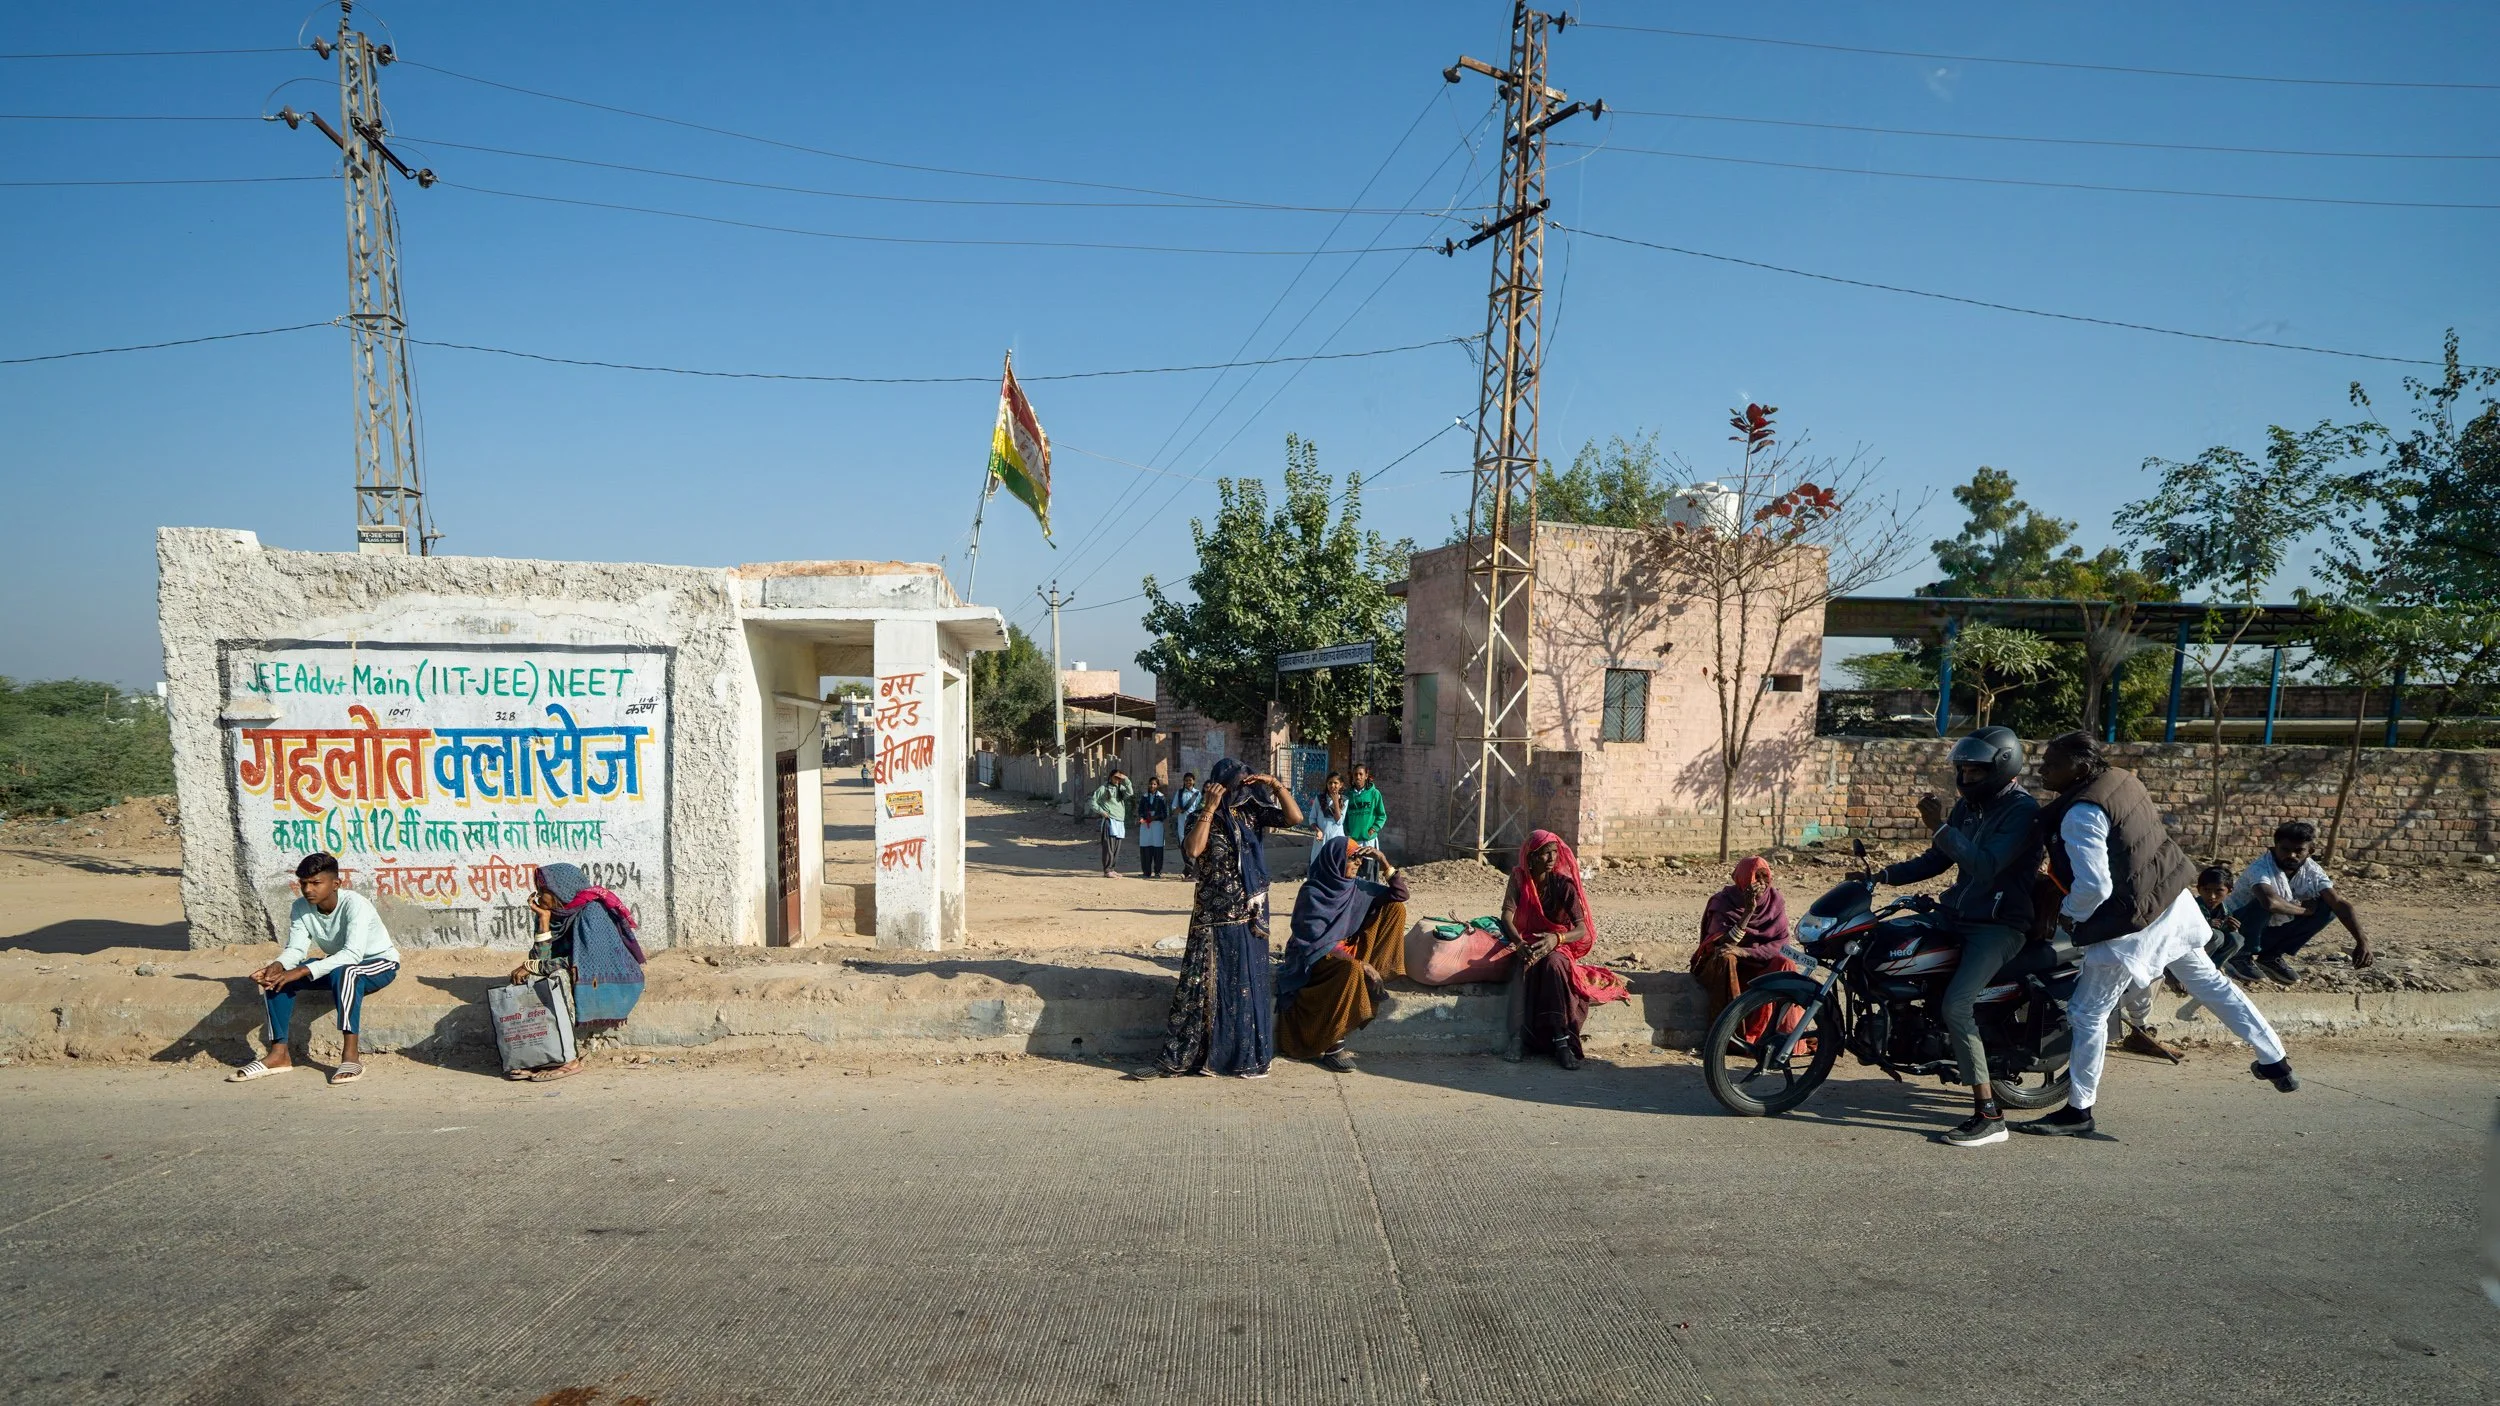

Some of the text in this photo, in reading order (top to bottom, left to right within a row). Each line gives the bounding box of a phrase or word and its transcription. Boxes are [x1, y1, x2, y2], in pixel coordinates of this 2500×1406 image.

[353, 664, 409, 697] Main
[415, 658, 539, 706] (IIT-JEE)
[548, 668, 634, 698] NEET
[878, 672, 926, 697] बस
[495, 711, 516, 721] 328
[239, 703, 650, 815] गहलोत क्लासेज
[874, 734, 935, 785] बीनावास
[272, 819, 321, 855] कक्षा
[325, 806, 343, 853] 6
[347, 806, 367, 853] से
[370, 807, 397, 852] 12
[398, 807, 422, 852] वीं
[425, 820, 459, 852] तक
[503, 820, 530, 851] का
[374, 857, 459, 899] हॉस्टल
[467, 854, 540, 902] सुविधा
[881, 838, 928, 872] करण
[1889, 949, 1913, 957] Hero
